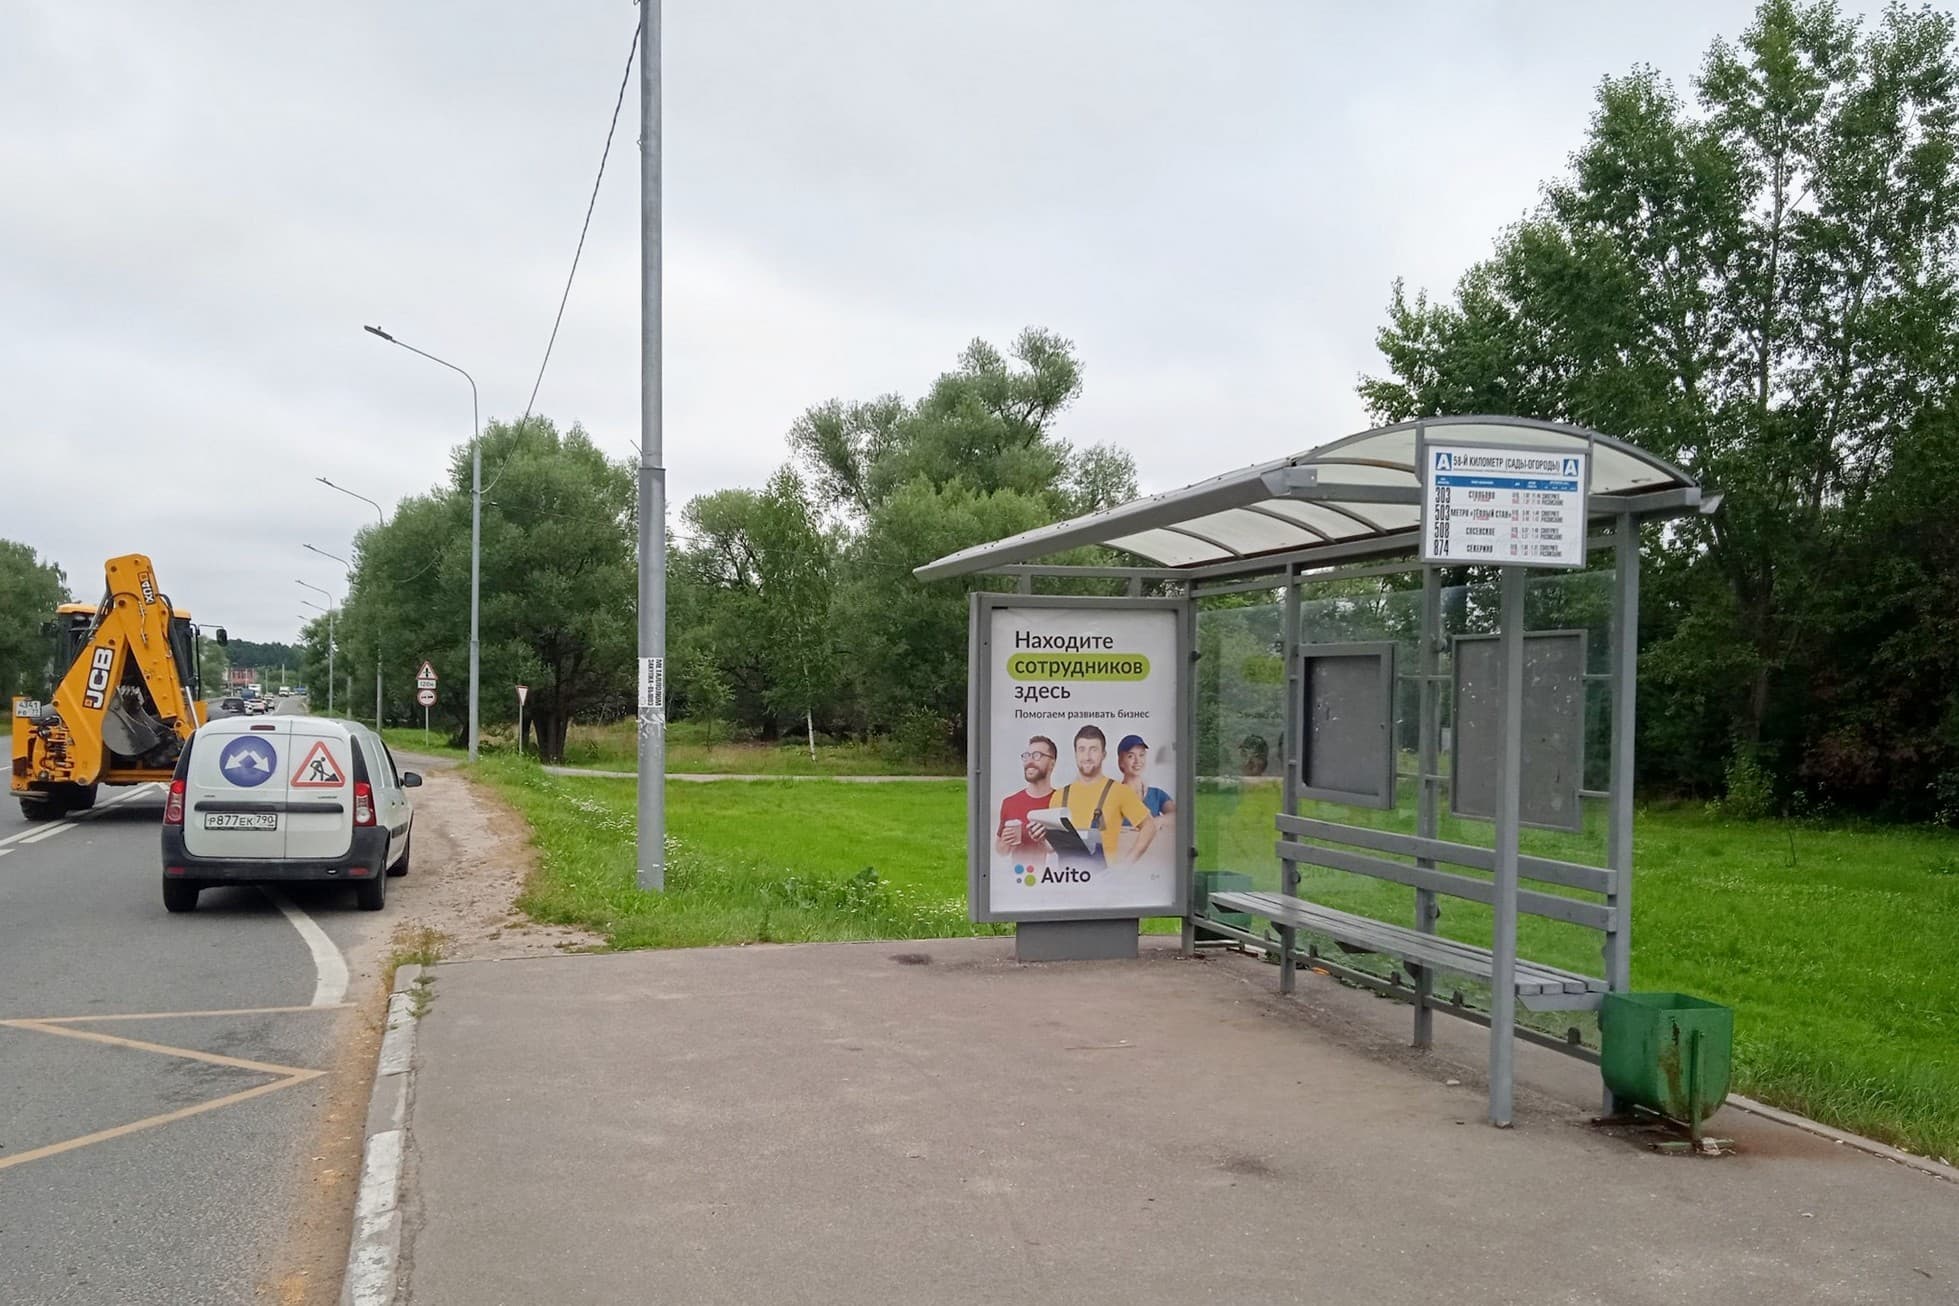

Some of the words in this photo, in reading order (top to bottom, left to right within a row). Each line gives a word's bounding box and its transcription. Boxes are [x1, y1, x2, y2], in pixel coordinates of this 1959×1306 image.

[1470, 456, 1504, 468] КИЛОМЕТР
[1435, 487, 1451, 503] 303
[1435, 504, 1450, 521] 503
[1435, 521, 1450, 538] 508
[1434, 539, 1449, 556] 874
[1015, 630, 1114, 652] Находите
[1014, 660, 1143, 678] сотрудников
[86, 648, 113, 709] JCB
[1014, 685, 1071, 702] здесь
[1015, 709, 1066, 719] Помогаем
[1068, 710, 1116, 721] развивать
[1117, 709, 1150, 719] бизнес
[1041, 866, 1091, 883] Avito
